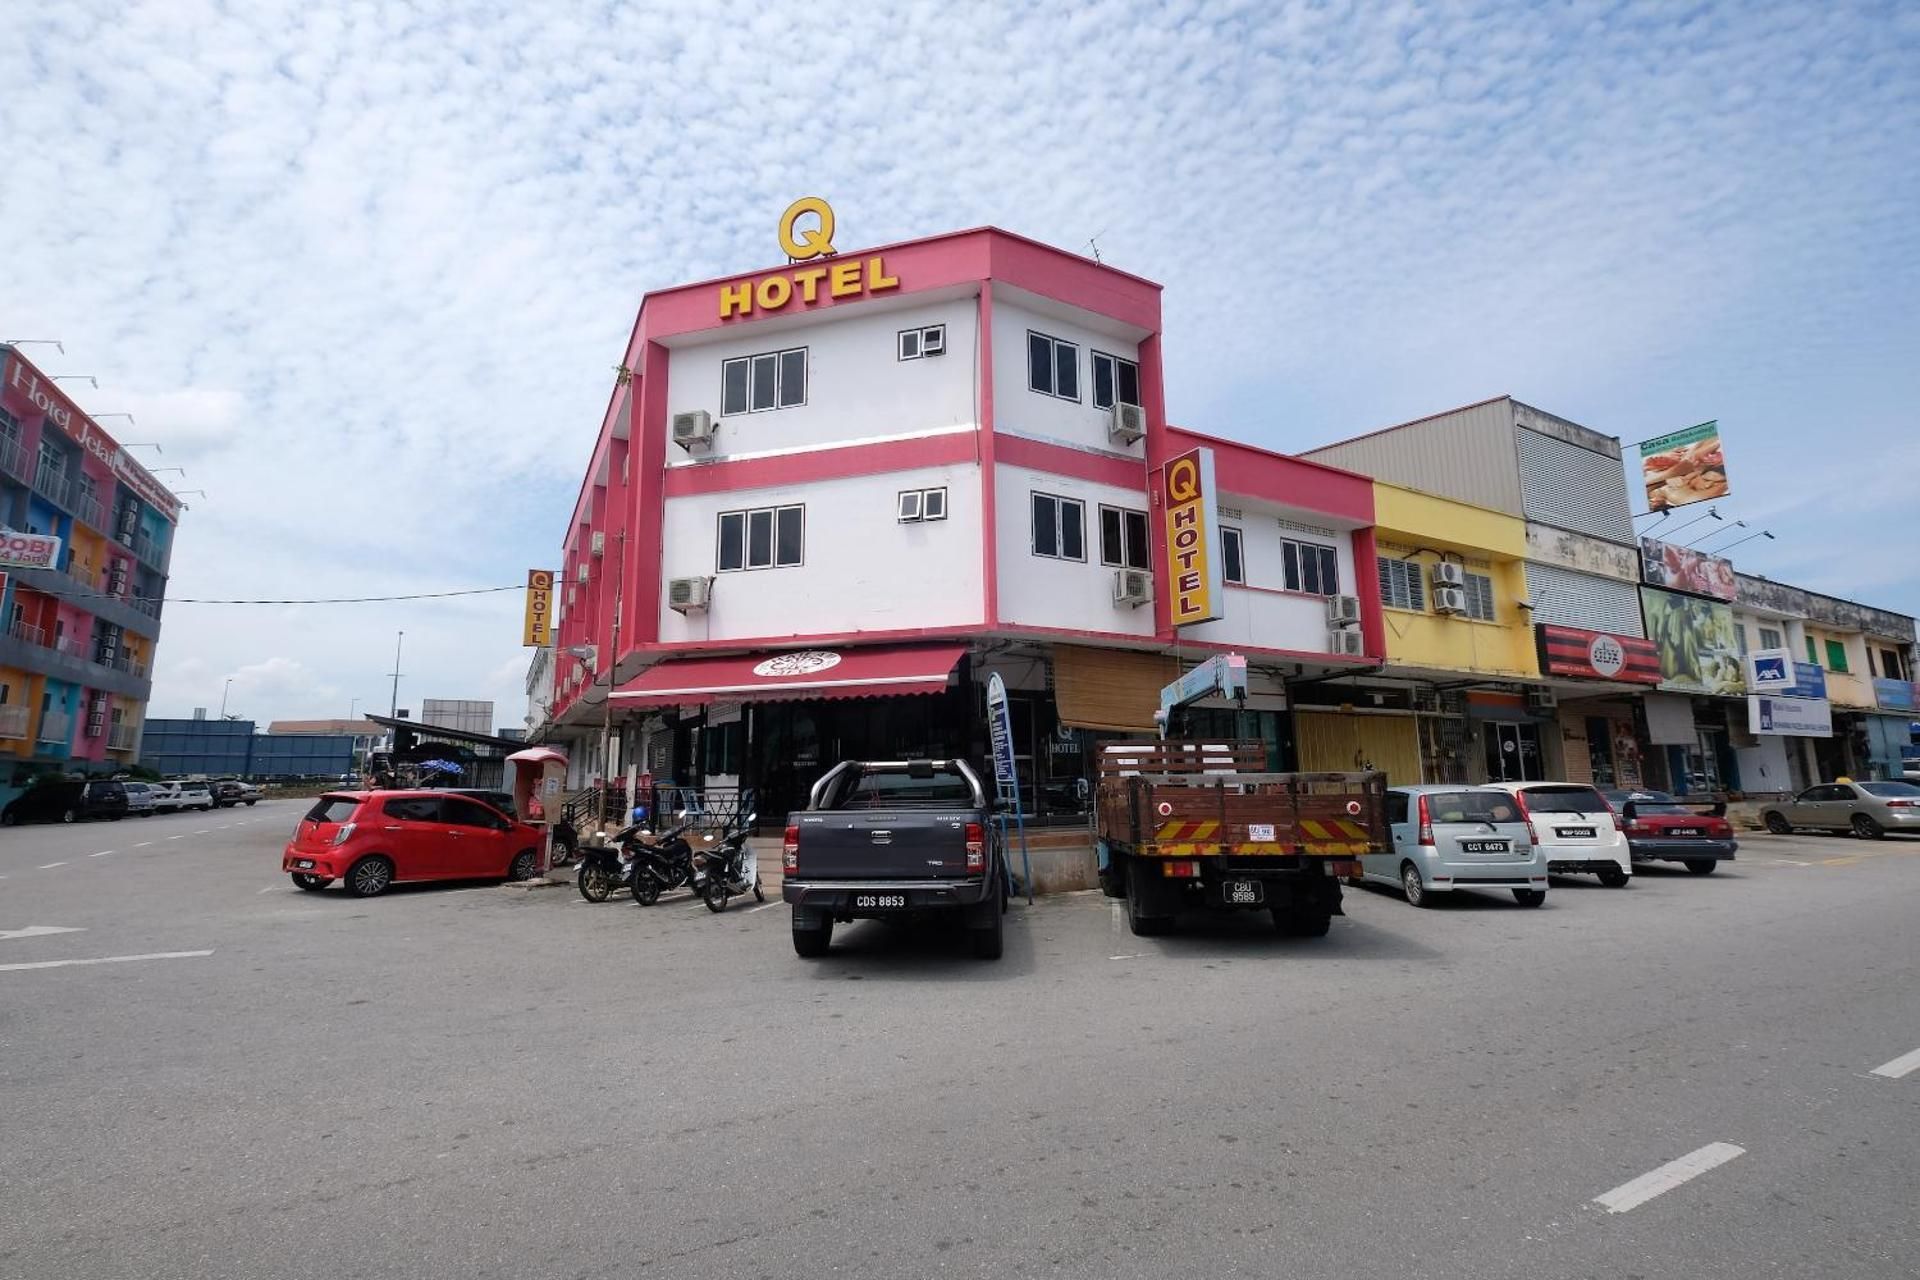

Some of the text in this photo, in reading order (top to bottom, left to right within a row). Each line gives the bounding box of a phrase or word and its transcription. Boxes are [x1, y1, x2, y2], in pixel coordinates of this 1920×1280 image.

[778, 196, 837, 260] Q
[719, 256, 899, 319] HOTEL
[11, 362, 117, 471] Hotel Jelai
[1169, 458, 1198, 501] Q
[531, 571, 551, 590] Q
[1174, 505, 1201, 616] HOTEL
[531, 590, 546, 644] HOTEL
[1757, 668, 1781, 681] AXA
[1051, 743, 1081, 754] HOTEL
[856, 896, 905, 907] CDS 8853
[1232, 891, 1256, 902] 9589
